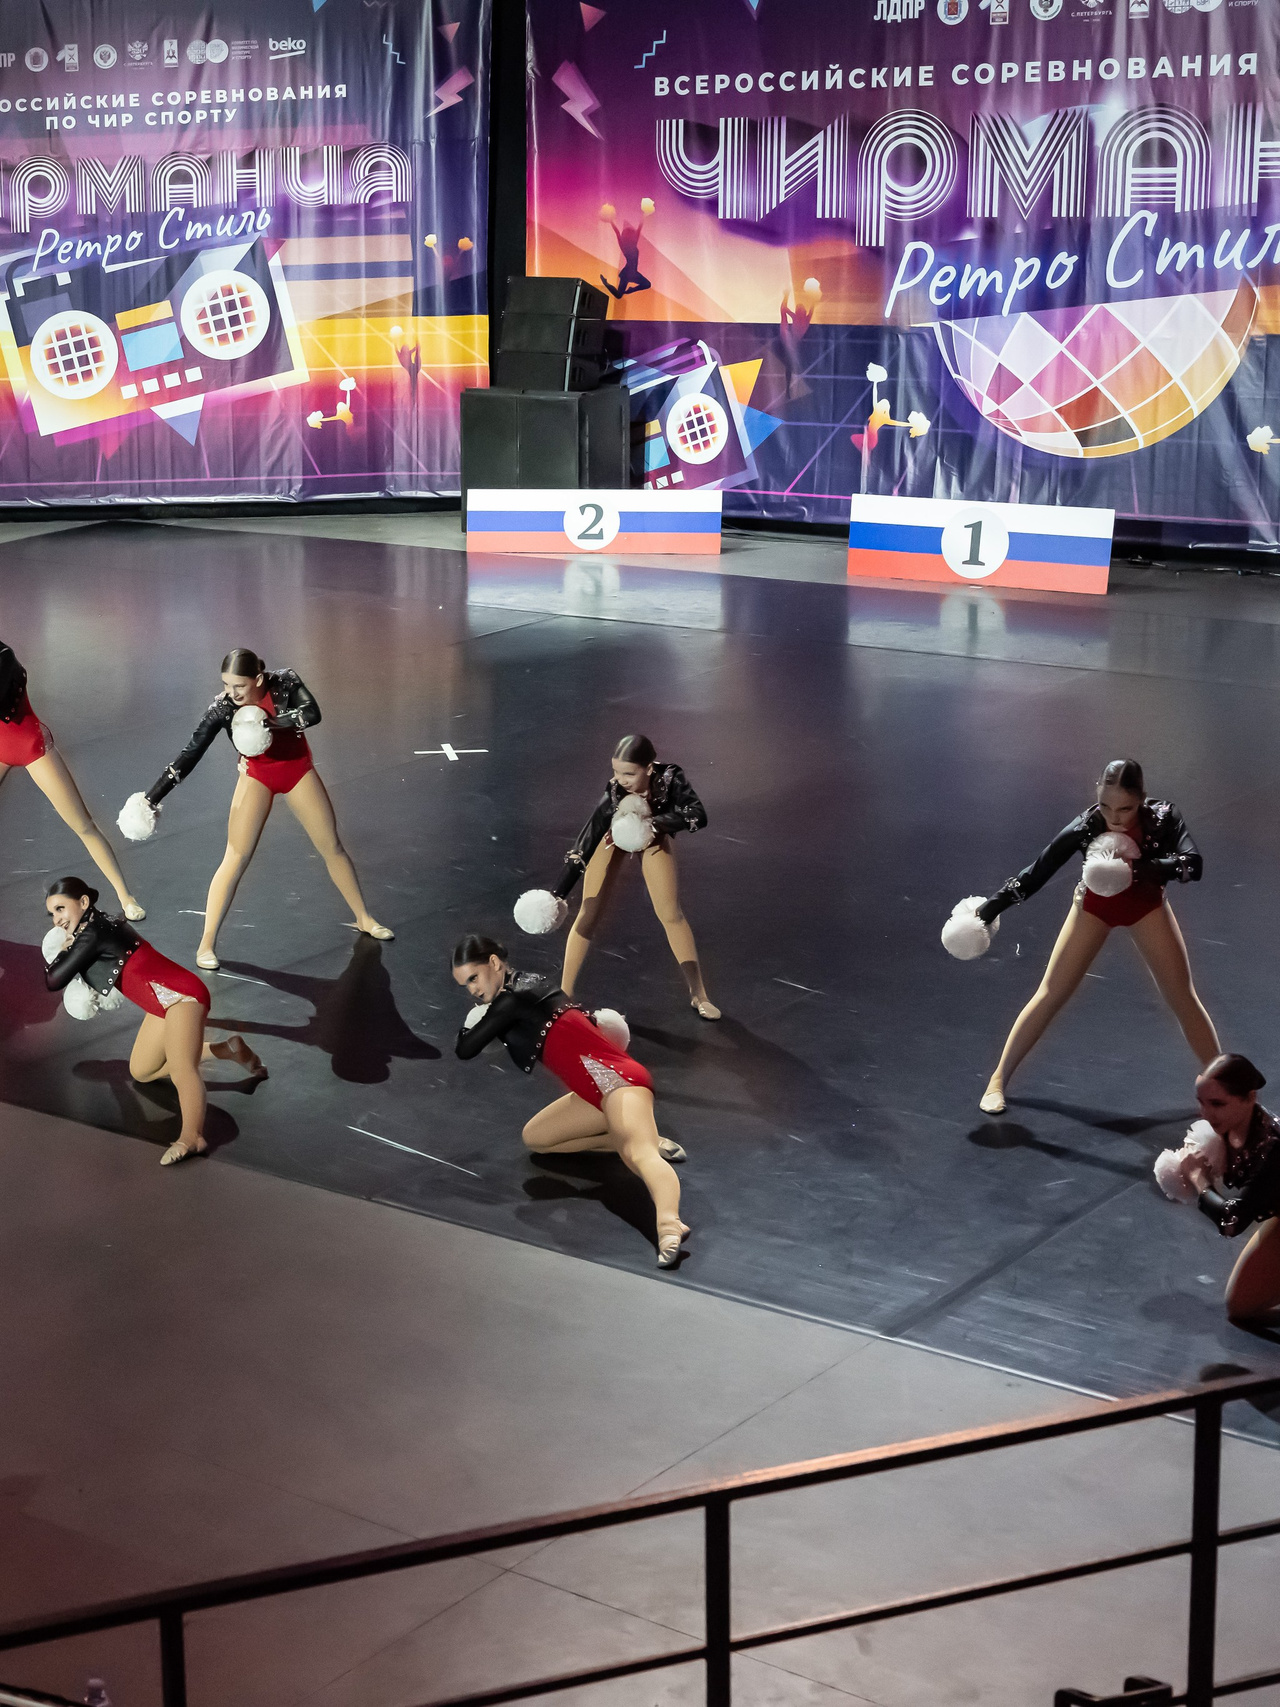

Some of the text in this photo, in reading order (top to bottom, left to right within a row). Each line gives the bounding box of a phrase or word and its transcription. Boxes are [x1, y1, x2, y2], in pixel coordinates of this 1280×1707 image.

[873, 0, 925, 23] ЛДПР
[269, 37, 307, 51] beko
[654, 52, 1258, 97] ВСЕРОССИЙСКИЕ СОРЕВНОВАНИЯ
[151, 84, 348, 107] СОРЕВНОВАНИЯ
[45, 108, 237, 130] ПО ЧИР СПОРТУ
[32, 206, 272, 273] Ретро Стиль
[884, 240, 1078, 318] Ретро
[577, 502, 605, 541] 2
[961, 519, 986, 567] 1
